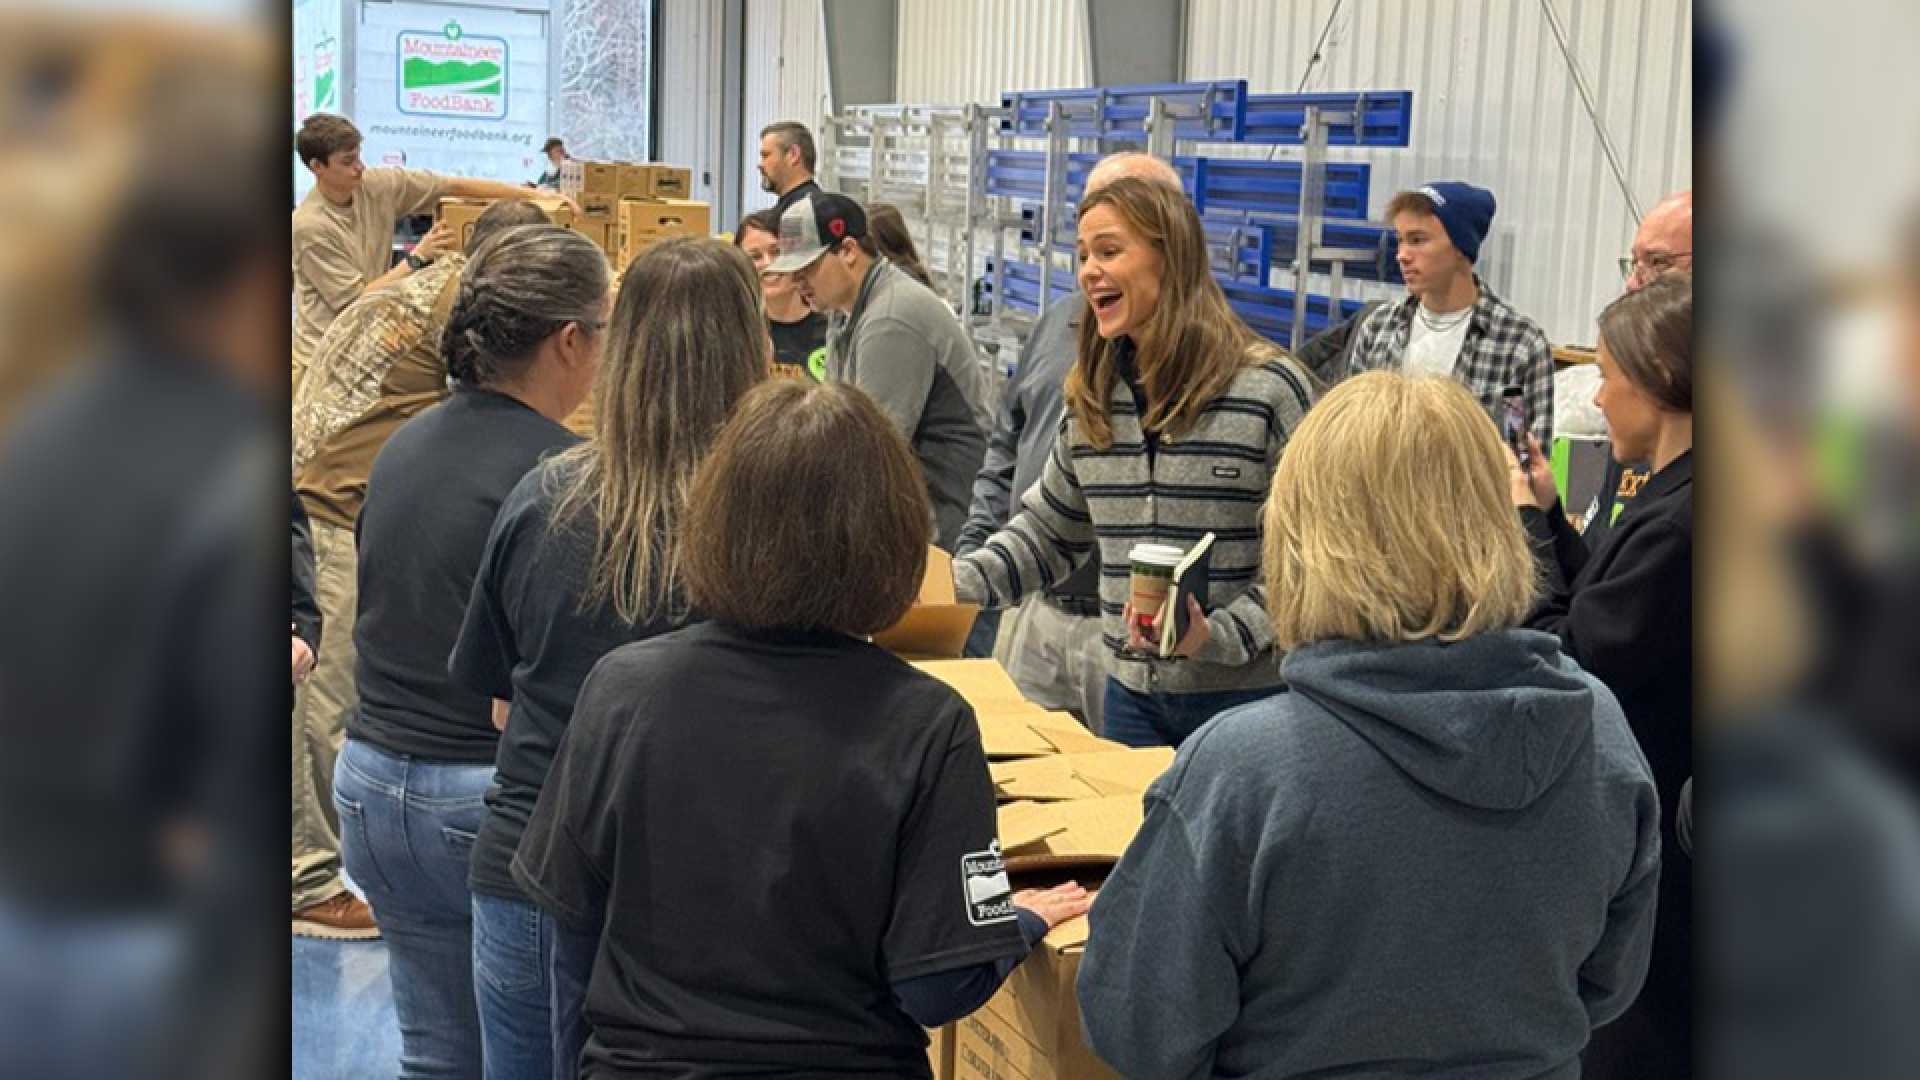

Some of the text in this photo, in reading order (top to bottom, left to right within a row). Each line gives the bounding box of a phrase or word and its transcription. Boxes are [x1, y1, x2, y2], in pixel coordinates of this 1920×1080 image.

[404, 37, 502, 59] Mountaineer
[409, 92, 495, 113] FoodBank
[369, 124, 533, 146] mountaineerfoodbank.org
